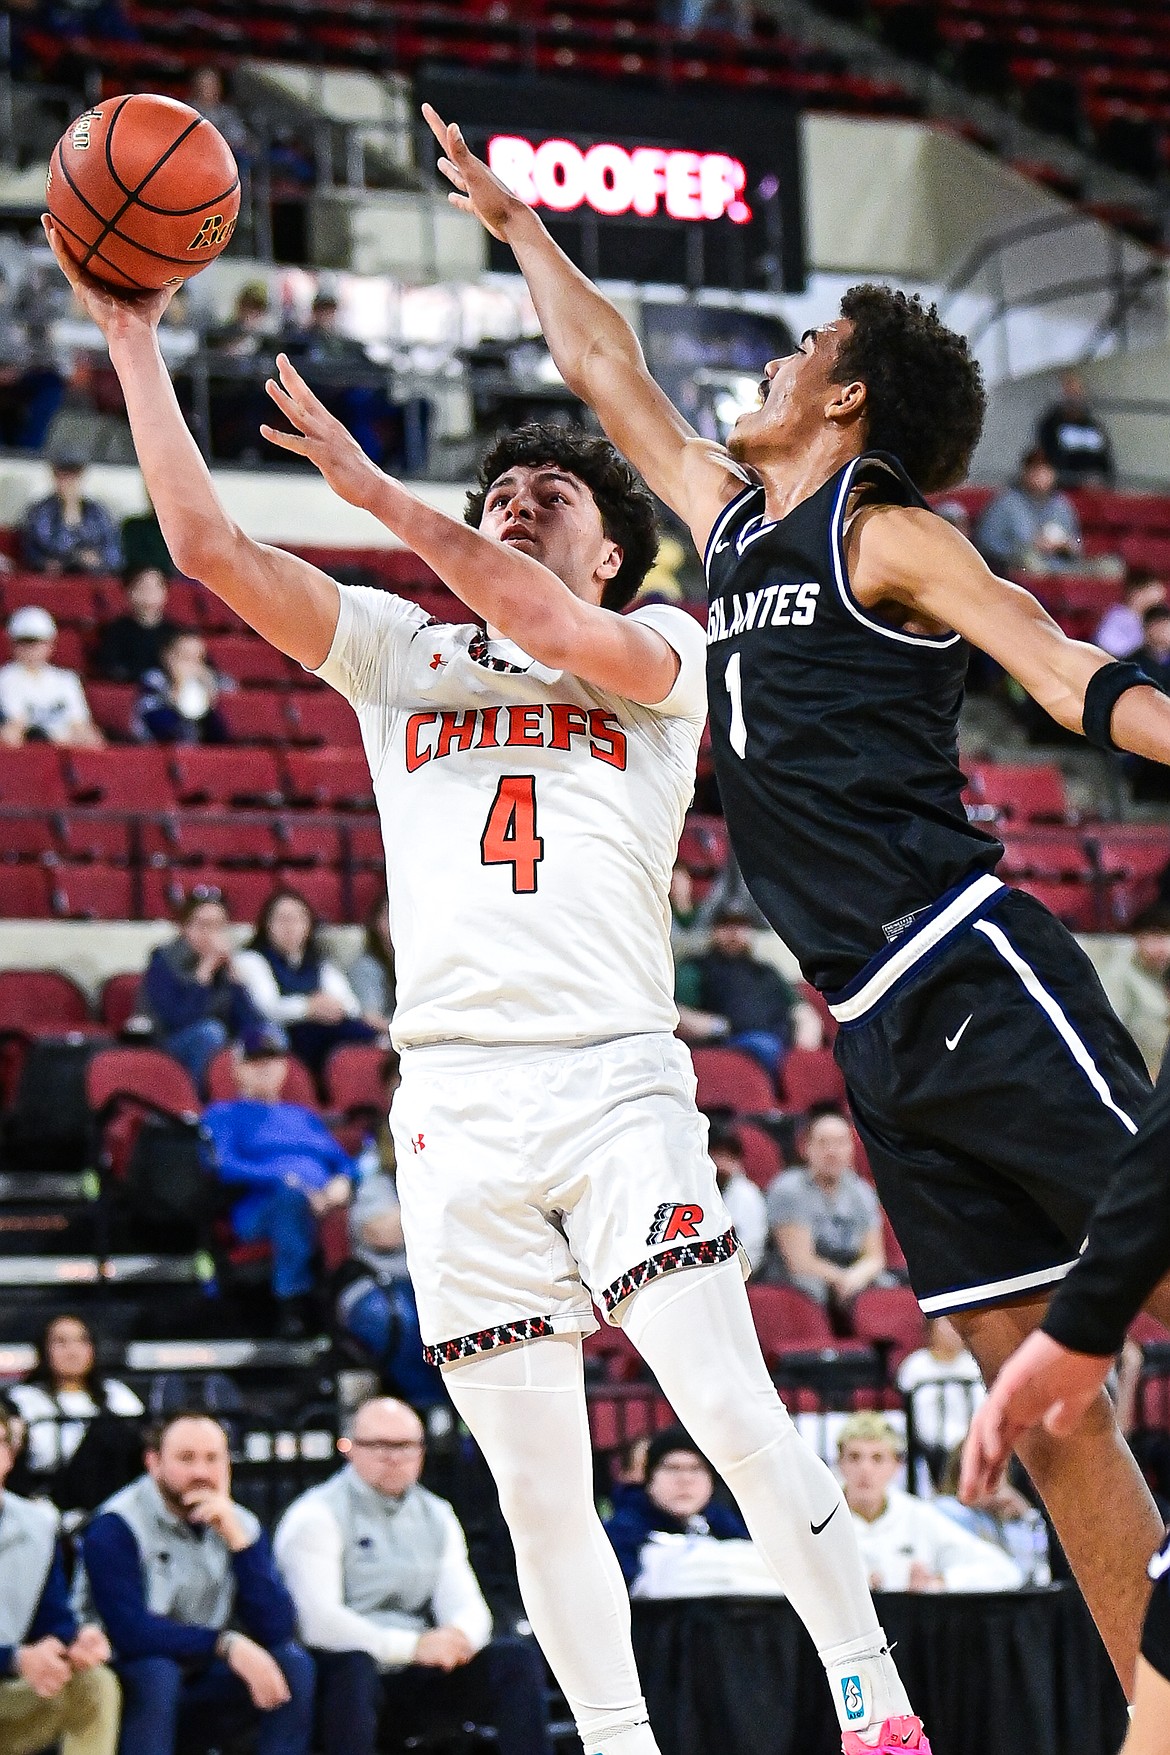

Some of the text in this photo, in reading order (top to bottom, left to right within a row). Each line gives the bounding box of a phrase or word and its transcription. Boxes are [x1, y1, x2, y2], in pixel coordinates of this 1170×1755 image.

[405, 703, 628, 773] CHIEFS
[724, 651, 748, 760] 1
[480, 774, 544, 894] 4
